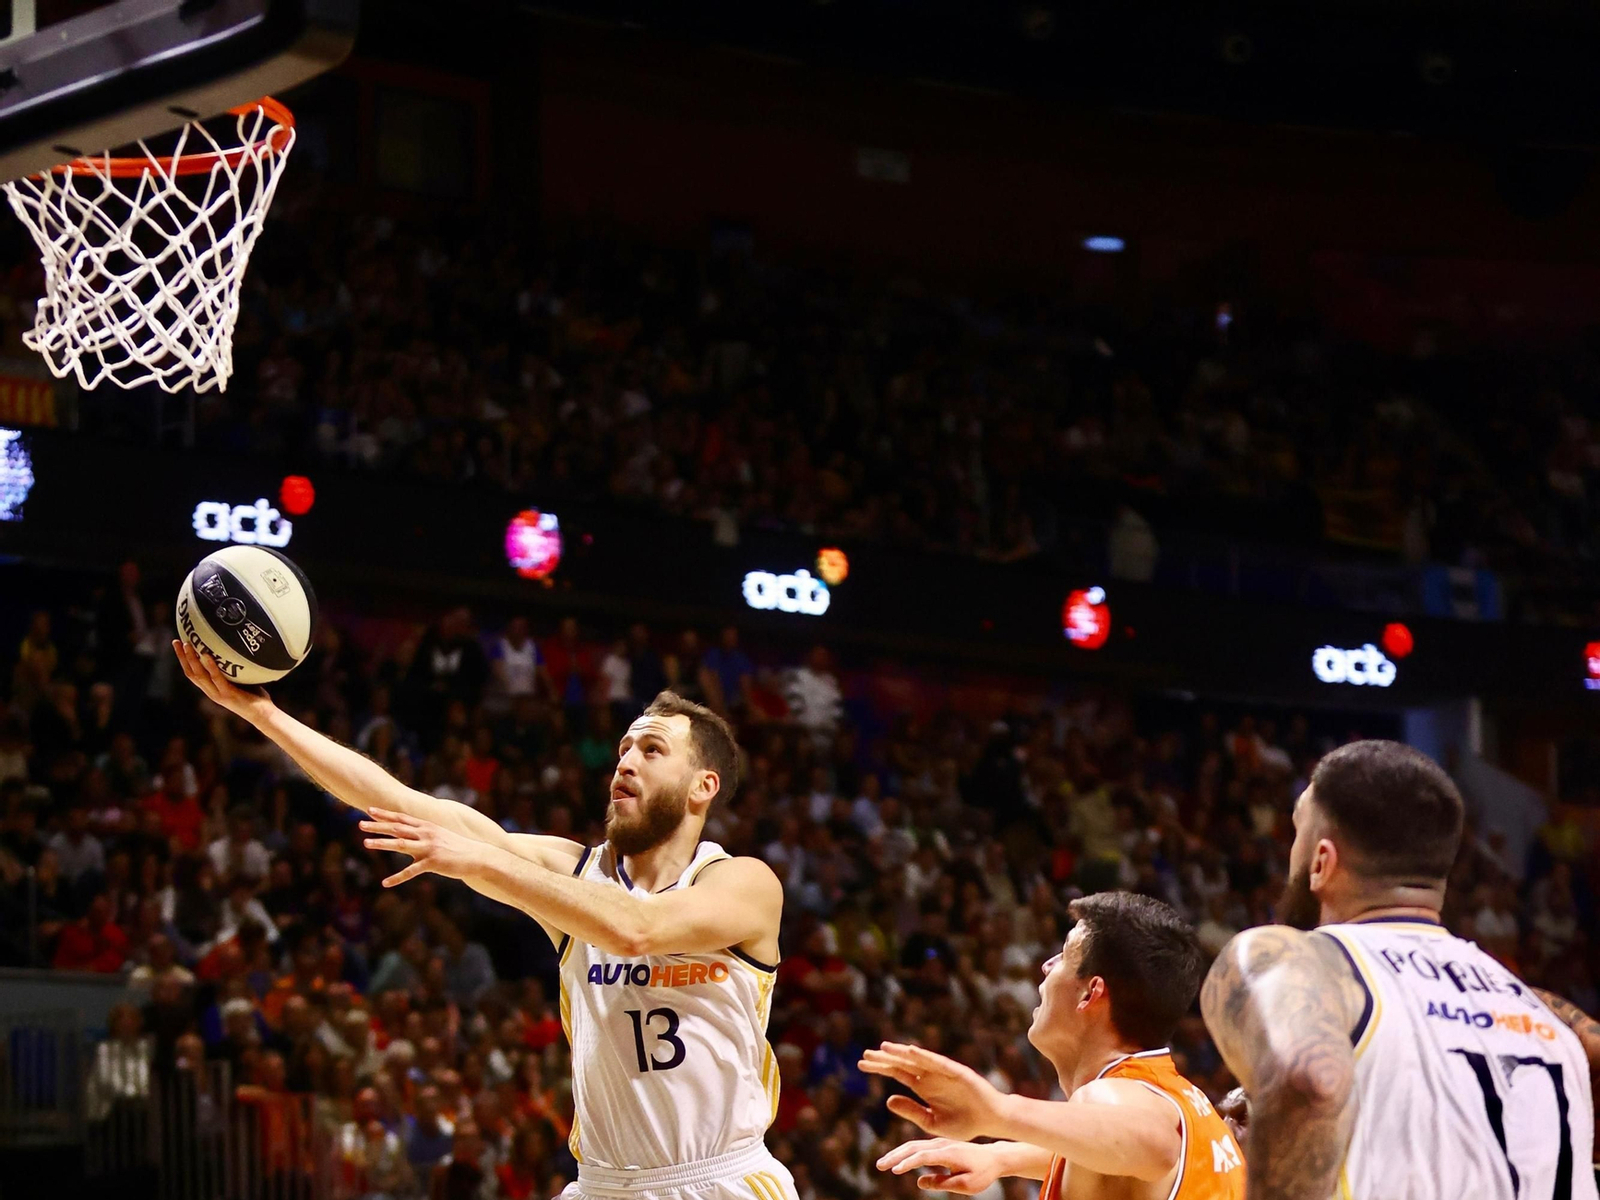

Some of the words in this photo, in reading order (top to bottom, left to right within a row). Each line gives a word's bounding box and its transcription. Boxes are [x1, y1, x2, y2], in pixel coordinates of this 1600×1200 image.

[192, 498, 293, 548] acb
[742, 568, 831, 616] acb
[243, 628, 260, 652] Copa
[1312, 643, 1397, 687] acb
[587, 961, 730, 988] AUTOHERO
[623, 1007, 687, 1073] 13
